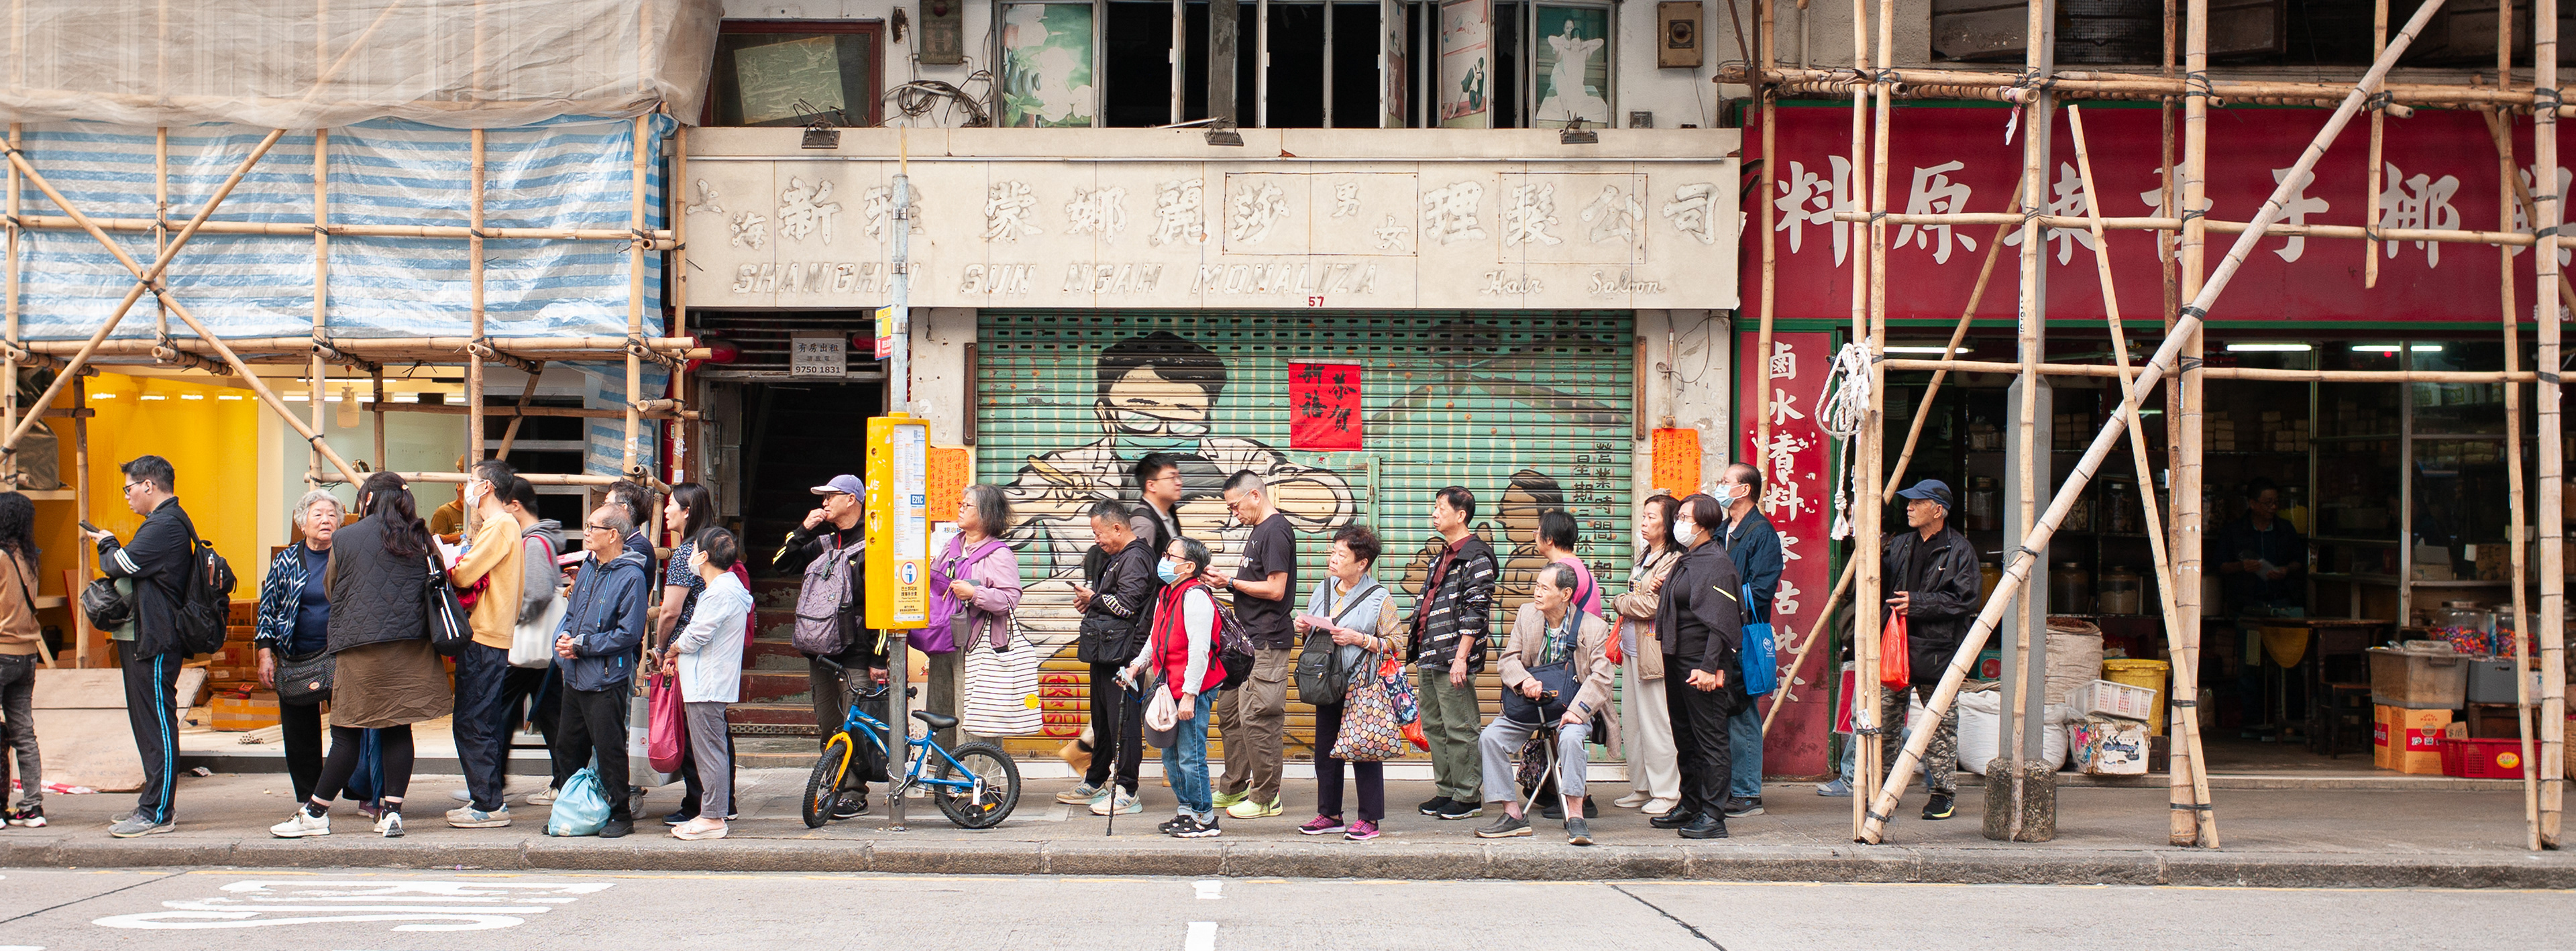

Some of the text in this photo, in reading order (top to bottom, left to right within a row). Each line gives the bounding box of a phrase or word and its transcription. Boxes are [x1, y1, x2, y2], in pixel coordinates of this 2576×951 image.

[960, 263, 1036, 294] SUN
[1063, 263, 1163, 294] NGAH
[1191, 263, 1377, 294] MONALIZA
[1481, 270, 1544, 294] Hair
[1309, 296, 1325, 307] 57
[798, 343, 839, 353] 有房出租
